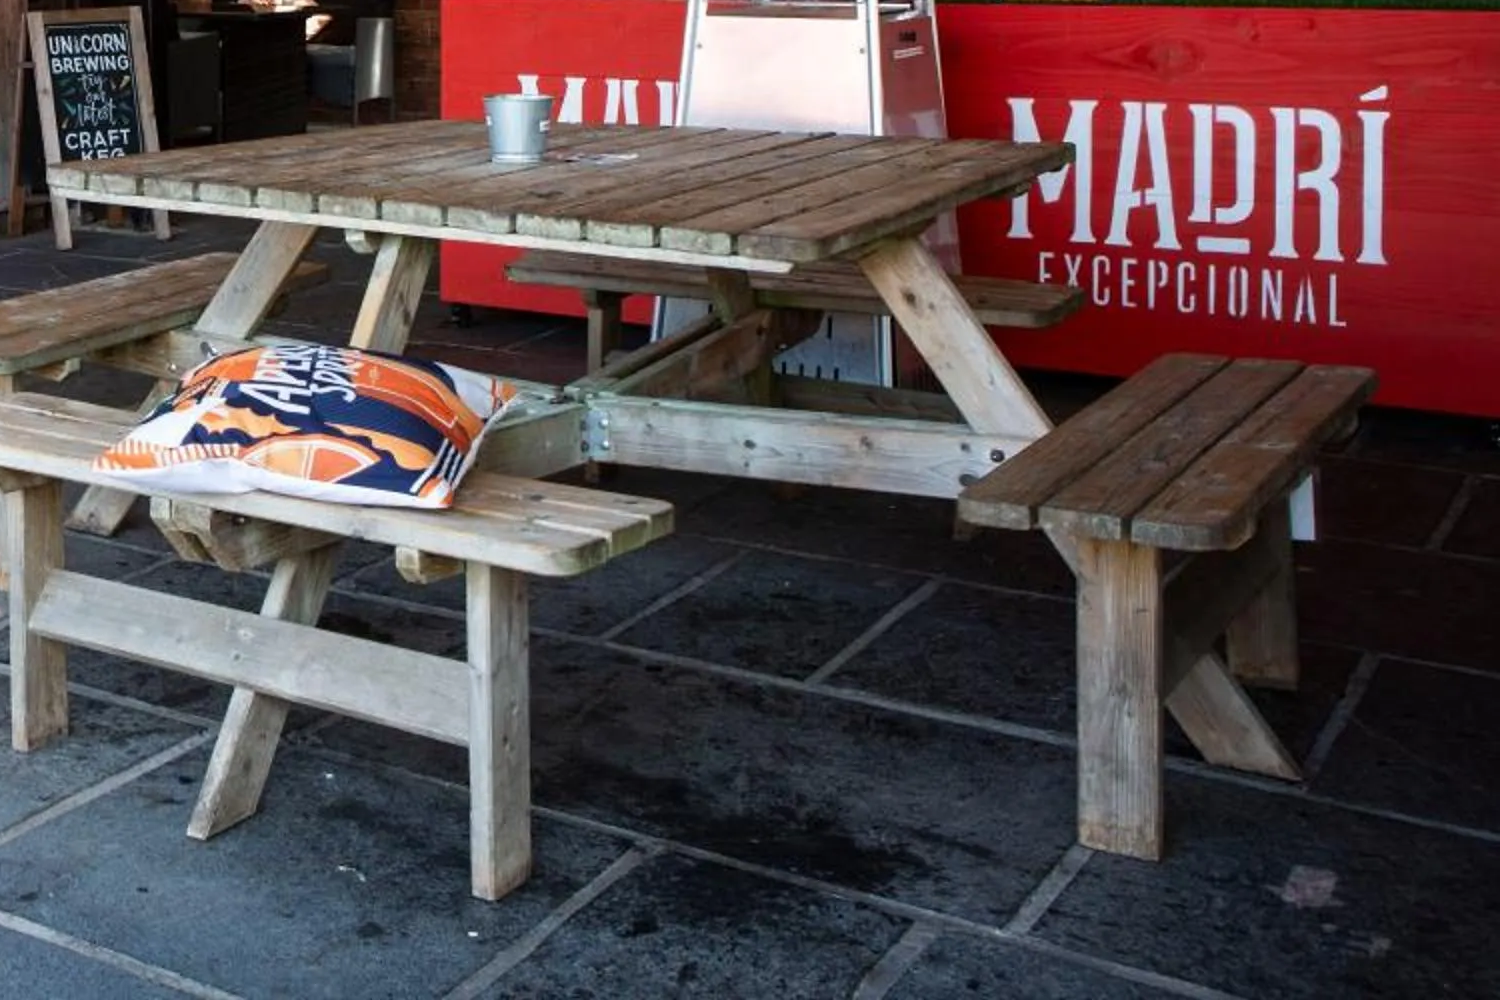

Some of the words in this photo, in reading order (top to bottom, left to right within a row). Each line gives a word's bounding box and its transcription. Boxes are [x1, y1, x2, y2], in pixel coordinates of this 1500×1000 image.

[51, 55, 129, 73] BREWING
[65, 129, 131, 150] CRAFT
[1007, 85, 1390, 265] MADRÍ
[1039, 251, 1347, 327] EXCEPCIONAL
